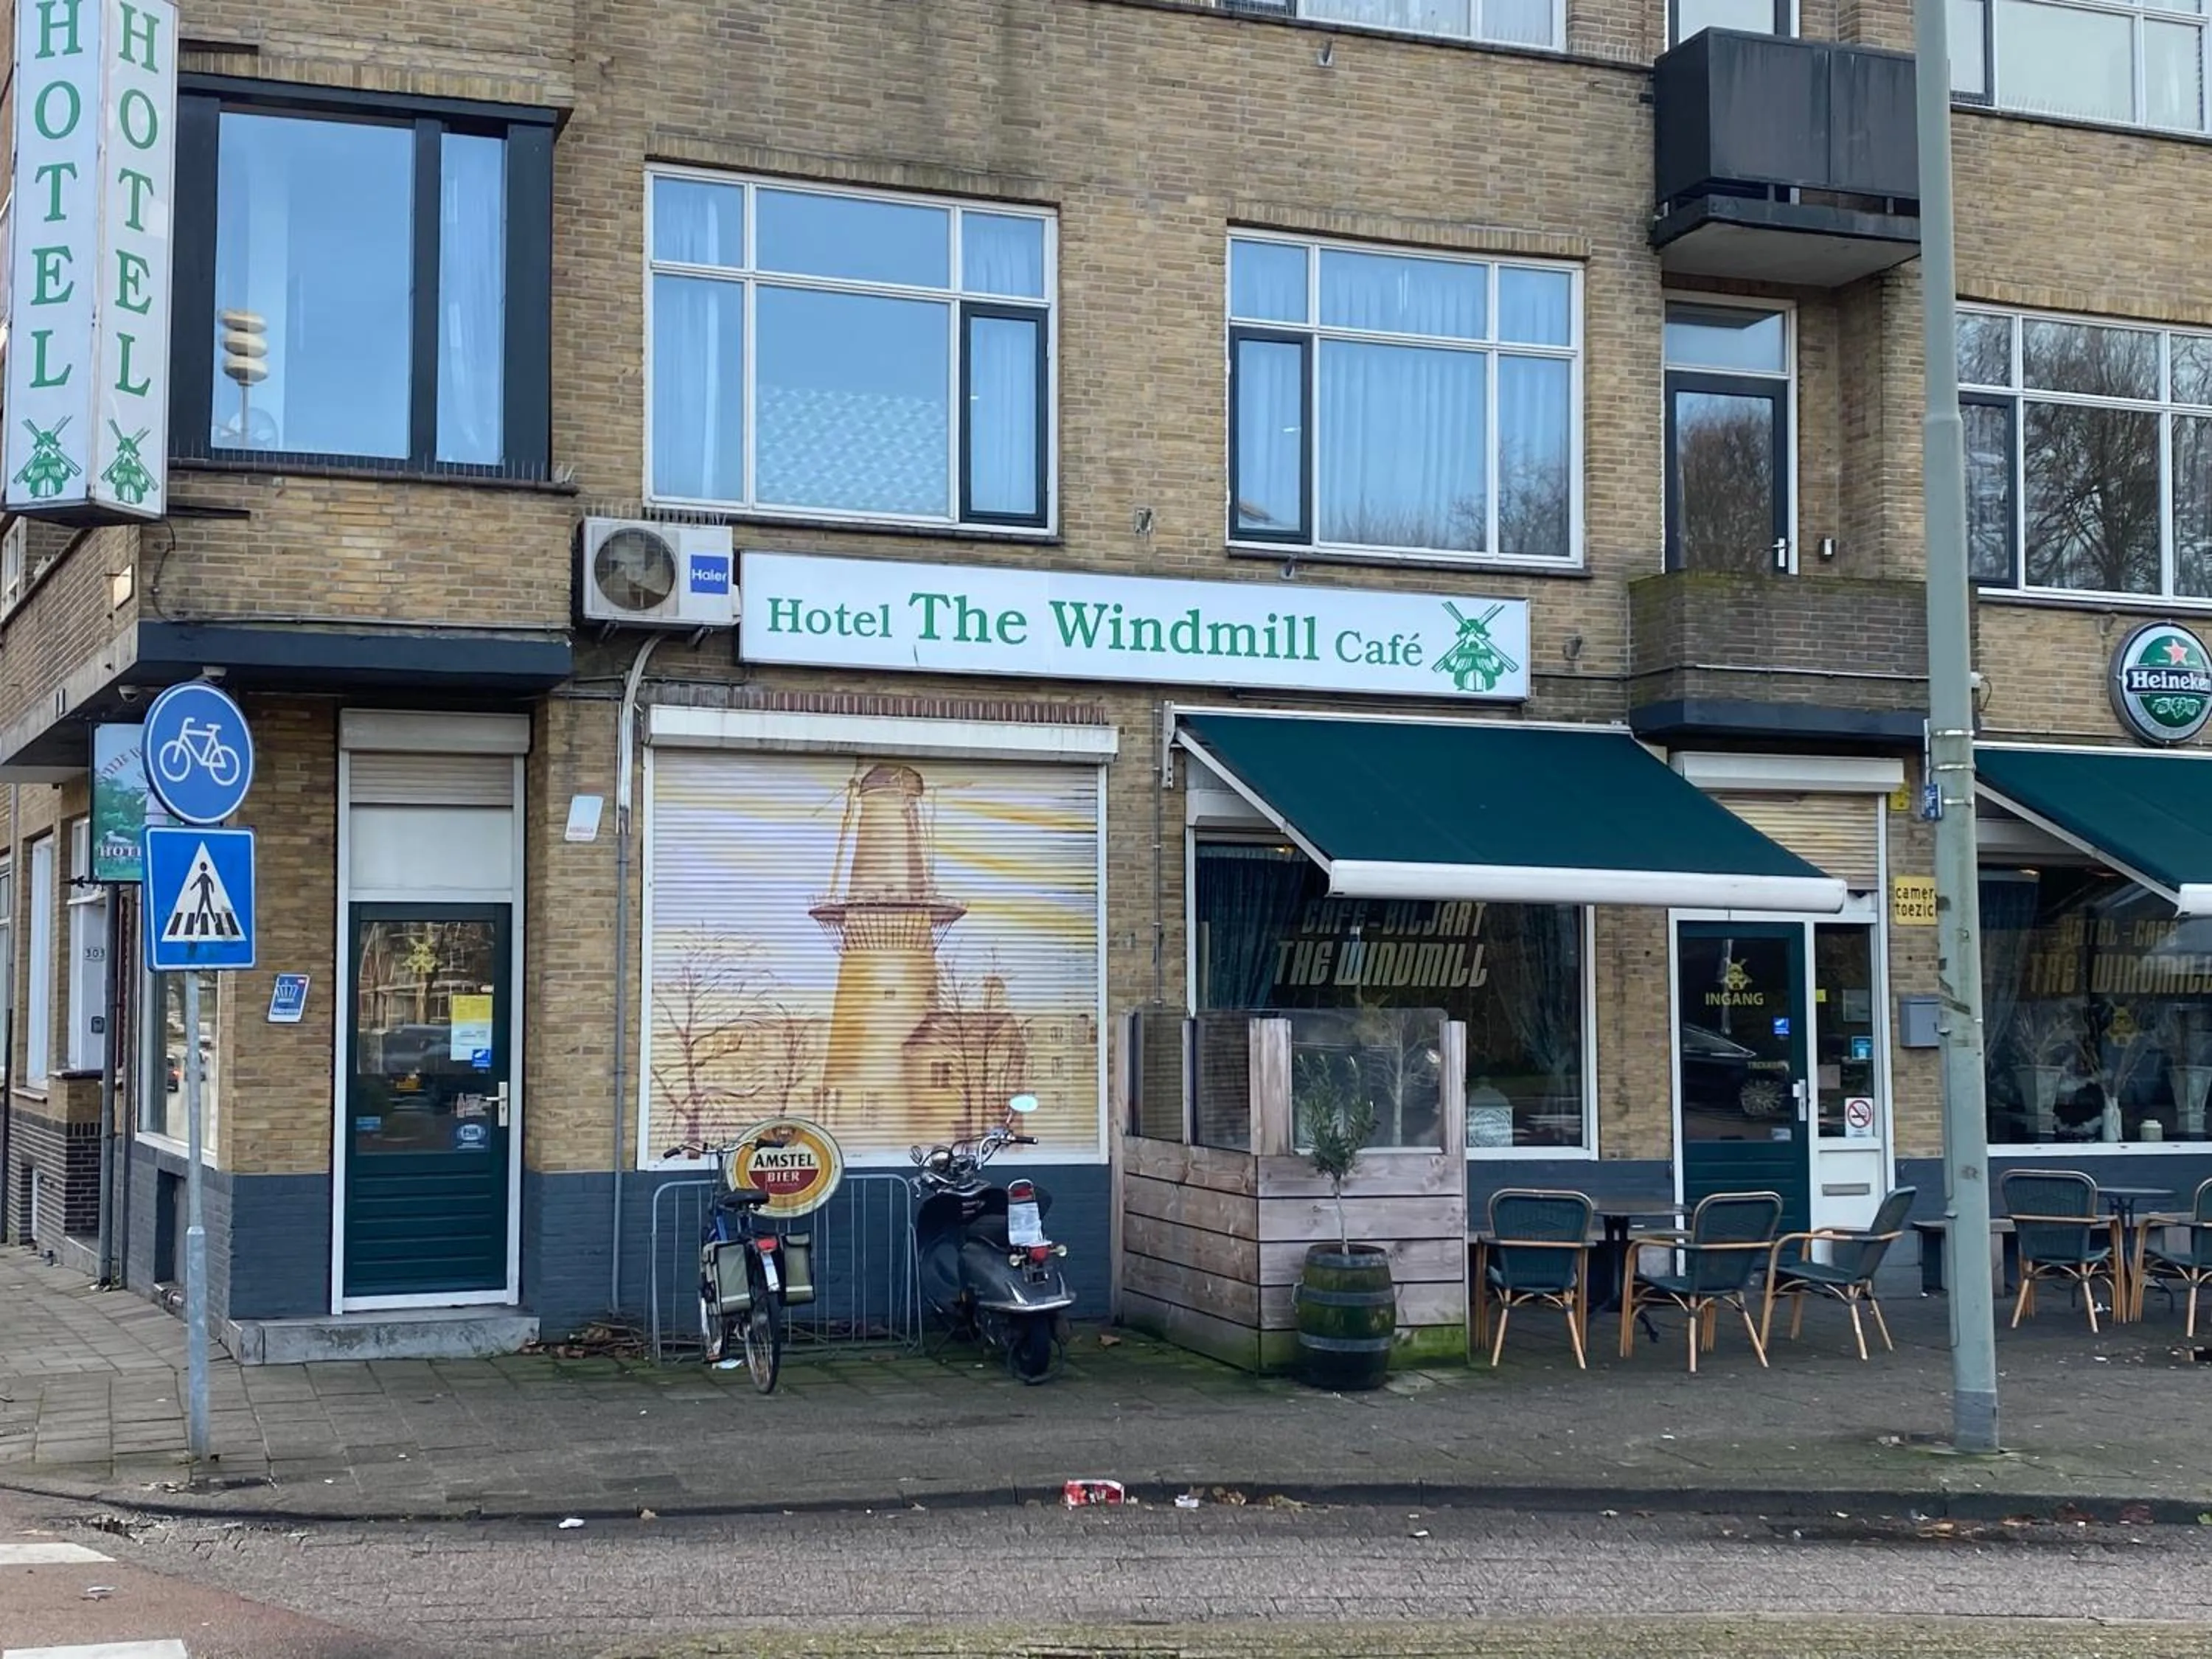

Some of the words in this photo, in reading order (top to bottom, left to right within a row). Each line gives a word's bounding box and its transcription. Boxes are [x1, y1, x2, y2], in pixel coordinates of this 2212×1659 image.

[29, 0, 83, 389] HOTEL
[115, 1, 159, 397] HOTEL
[692, 568, 728, 583] Haier
[767, 597, 892, 638] Hotel
[908, 592, 1028, 645] The
[1048, 600, 1320, 661] Windmill
[1335, 630, 1424, 667] Café
[1896, 887, 1938, 900] camer
[1895, 903, 1938, 917] toezic
[1274, 940, 1334, 986] THE
[1333, 941, 1487, 987] WINDMILL
[1705, 992, 1764, 1006] INGANG
[754, 1153, 815, 1168] AMSTEL
[768, 1170, 800, 1183] BIER
